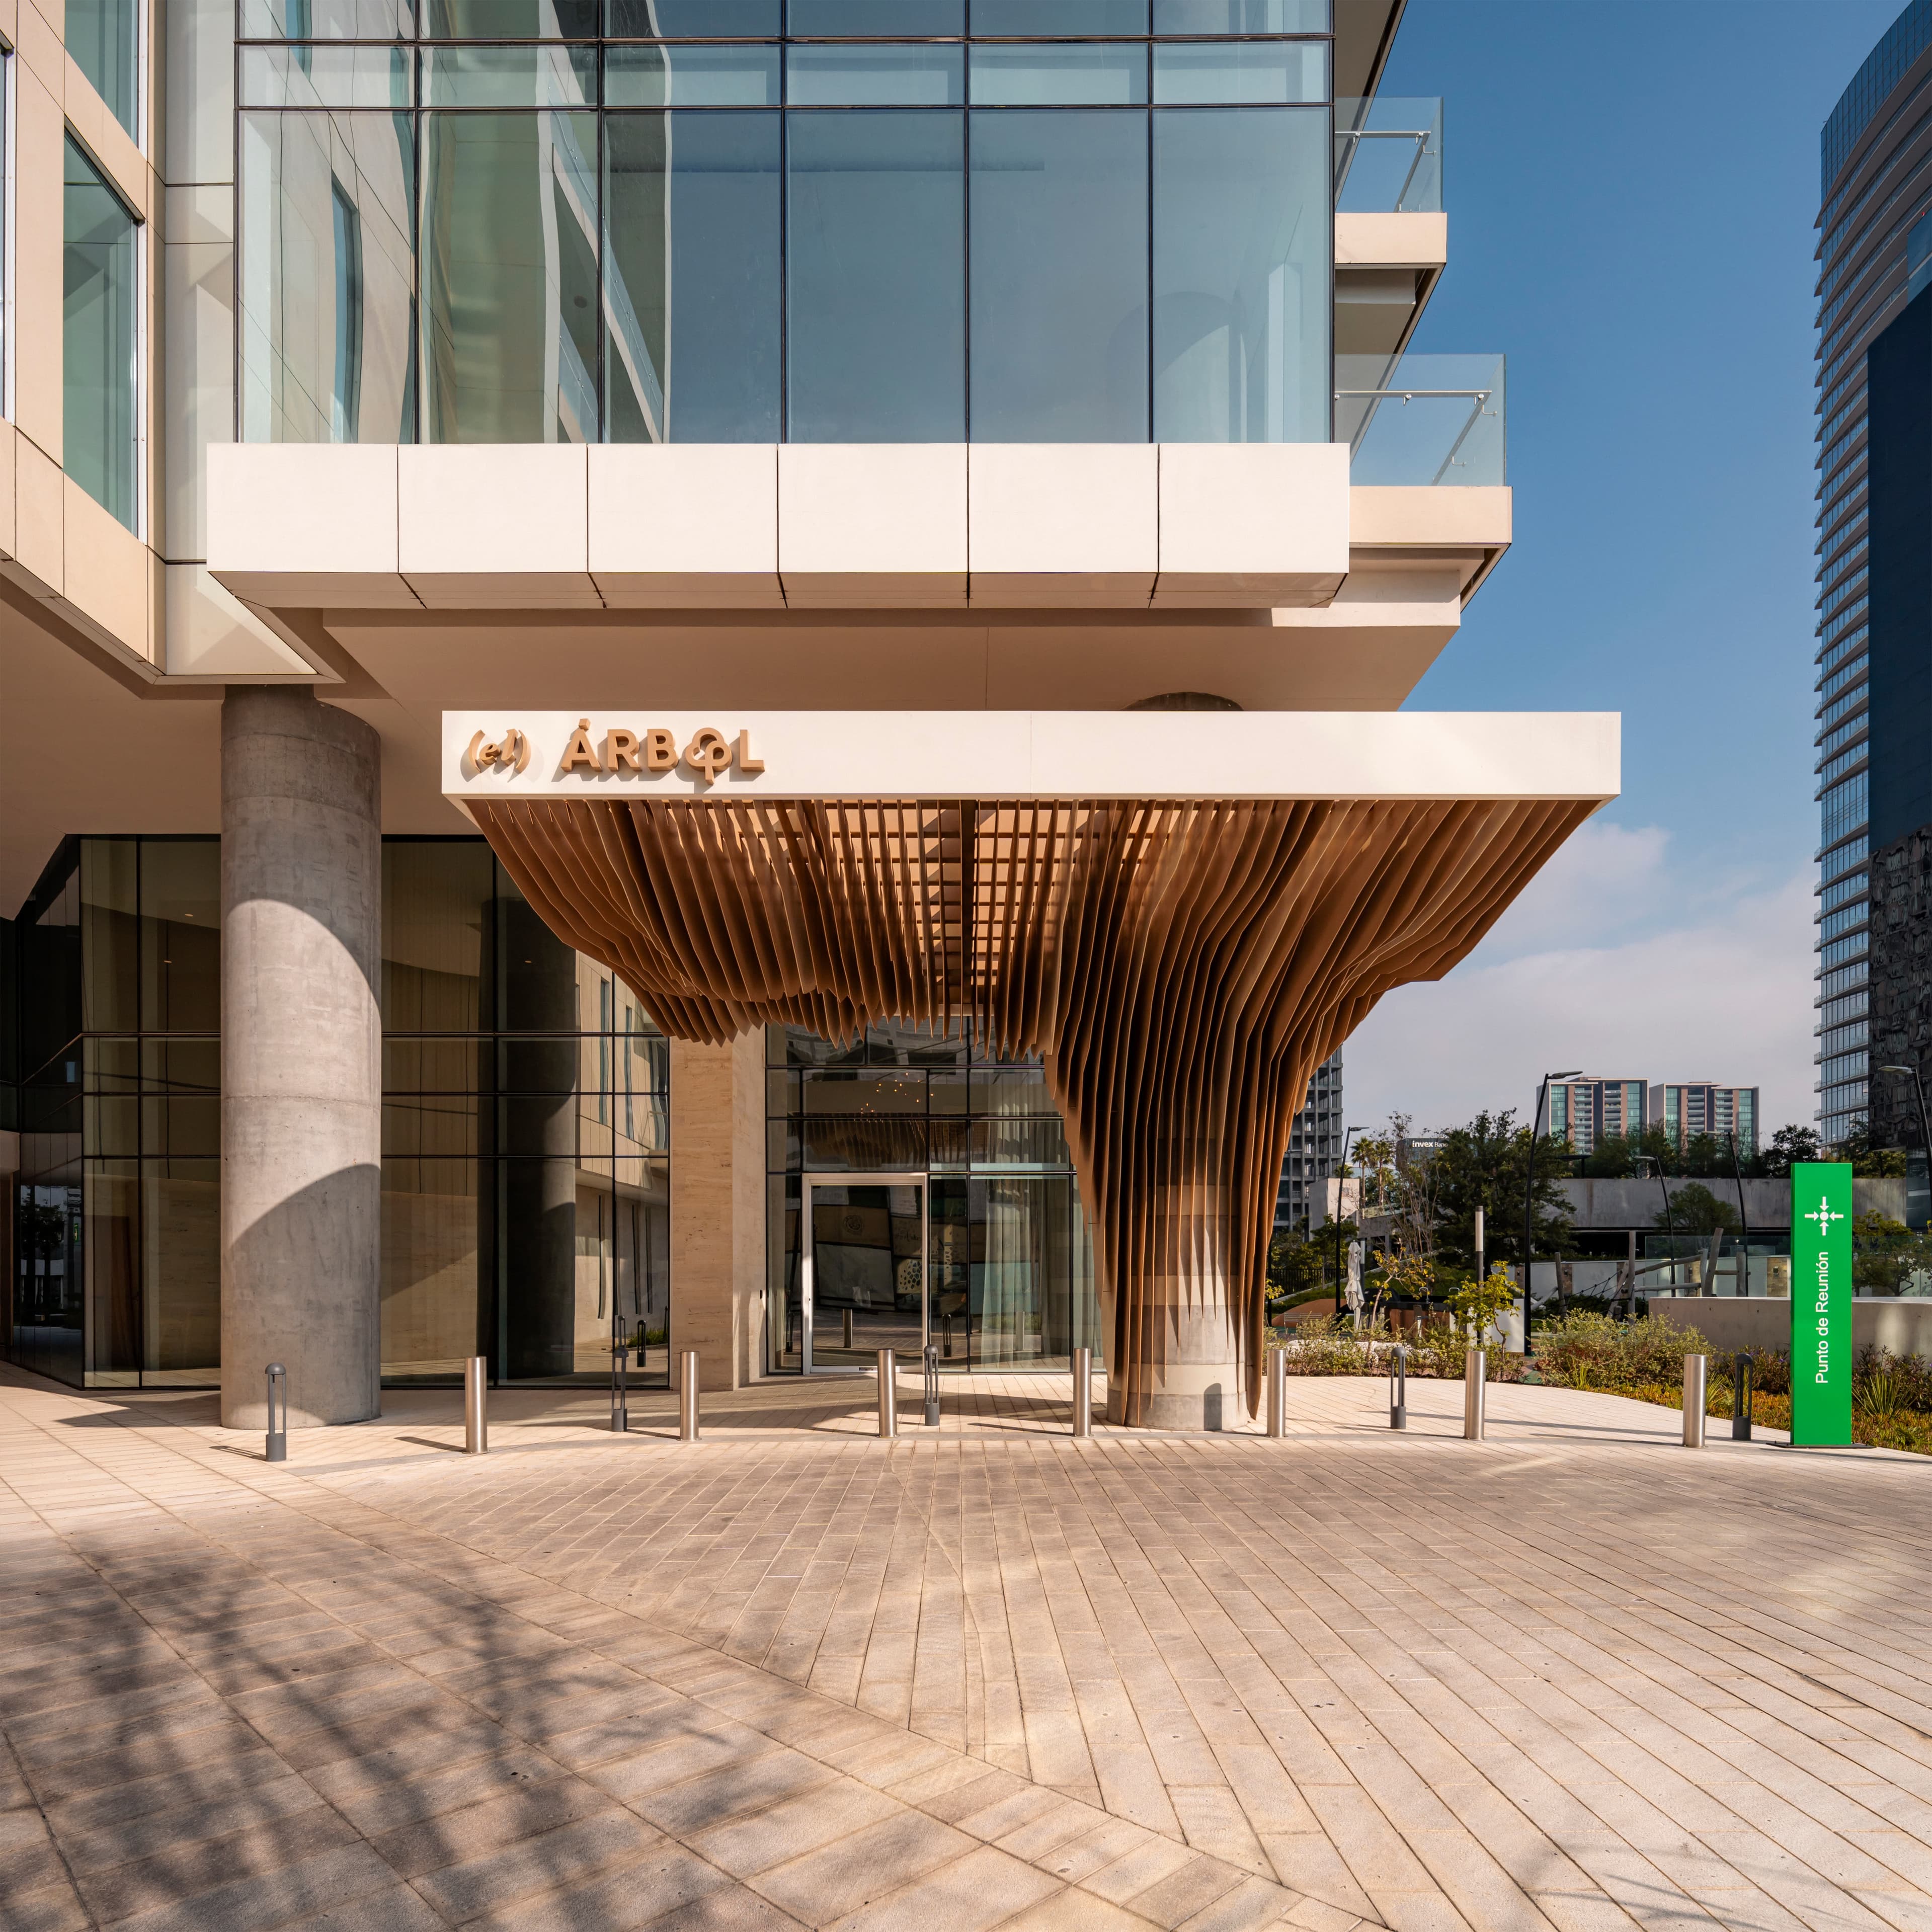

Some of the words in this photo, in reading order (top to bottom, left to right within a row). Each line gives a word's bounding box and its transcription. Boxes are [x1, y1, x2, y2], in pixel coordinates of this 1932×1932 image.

[468, 729, 531, 774] (el)
[1815, 1252, 1828, 1313] Reunión
[1815, 1318, 1828, 1336] de
[1815, 1340, 1828, 1383] Punto
